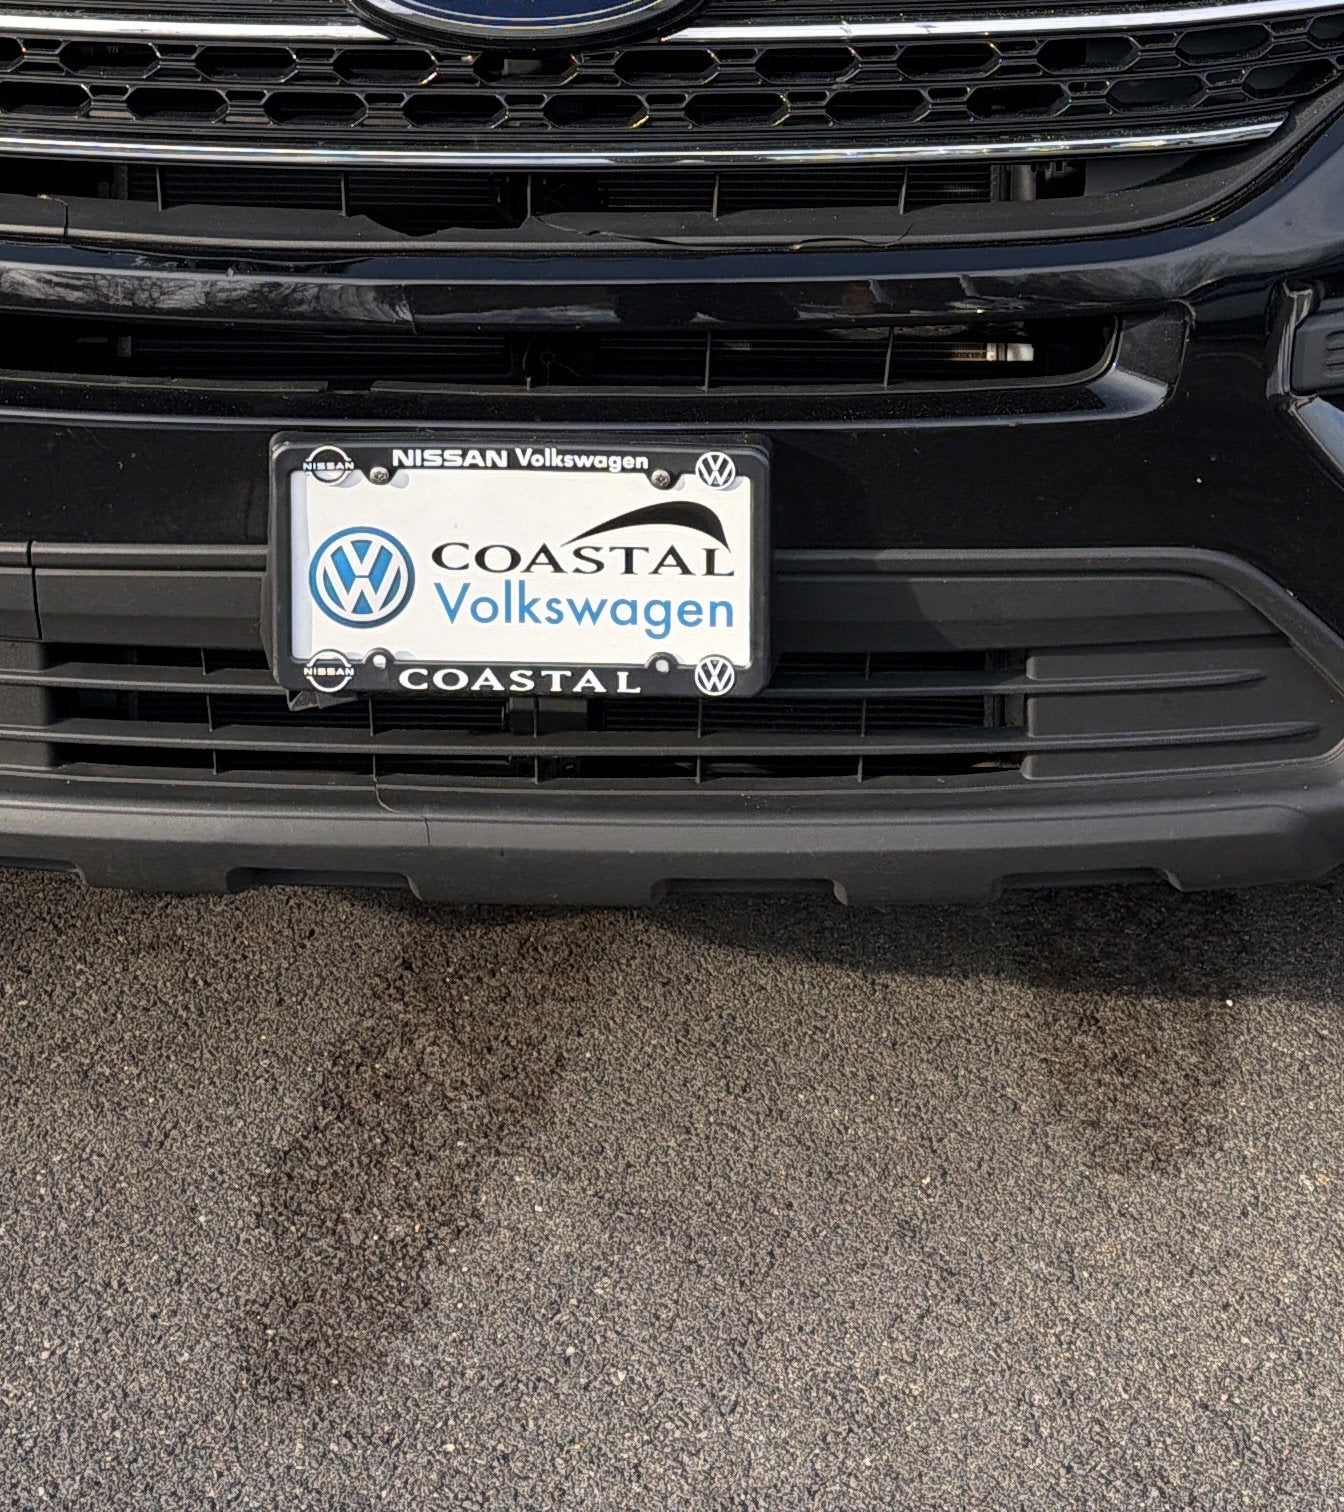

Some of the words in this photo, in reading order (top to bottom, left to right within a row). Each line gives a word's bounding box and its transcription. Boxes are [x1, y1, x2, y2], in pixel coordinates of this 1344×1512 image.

[302, 461, 355, 471] NISSAN
[392, 448, 508, 468] NISSAN
[515, 447, 649, 472] Volkswagen
[431, 542, 735, 577] COASTAL
[434, 579, 734, 640] Volkswagen
[303, 666, 354, 677] NISSAN
[399, 667, 641, 694] COASTAL
